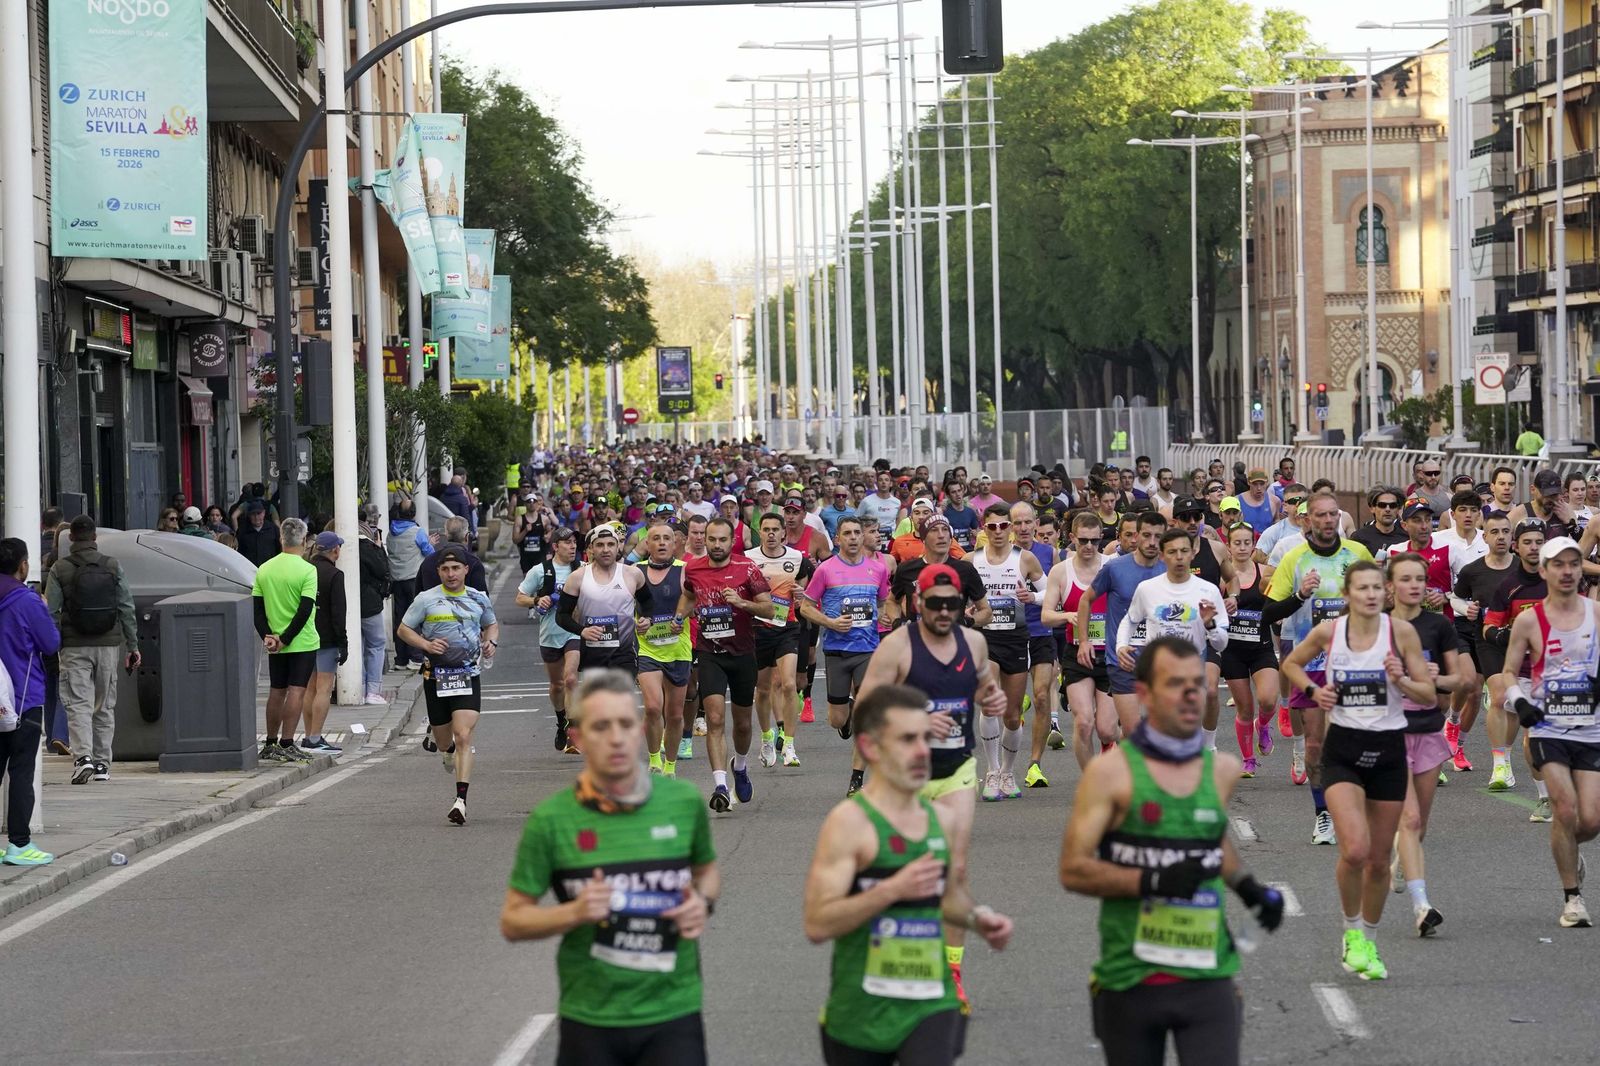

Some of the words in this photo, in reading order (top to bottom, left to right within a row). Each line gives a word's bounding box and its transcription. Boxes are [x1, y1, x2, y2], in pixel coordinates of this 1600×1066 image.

[88, 89, 146, 102] ZURICH
[86, 120, 148, 135] SEVILLA
[101, 148, 111, 157] 15
[113, 148, 160, 158] FEBRERO
[117, 159, 143, 169] 2026
[123, 202, 161, 211] ZURICH
[67, 240, 187, 251] www.zurichmaratonsevilla.es
[193, 333, 223, 345] TATTOO
[194, 354, 225, 367] PIERCING
[668, 400, 690, 409] 9:00
[594, 616, 615, 624] ZURICH
[705, 622, 730, 632] JUANLU
[1230, 625, 1258, 635] FRANCES
[1349, 672, 1380, 680] ZURICH
[442, 680, 467, 690] S.PEÑA
[1560, 682, 1590, 690] ZURICH
[1342, 694, 1377, 705] MARIE
[1548, 704, 1591, 714] GARBONI
